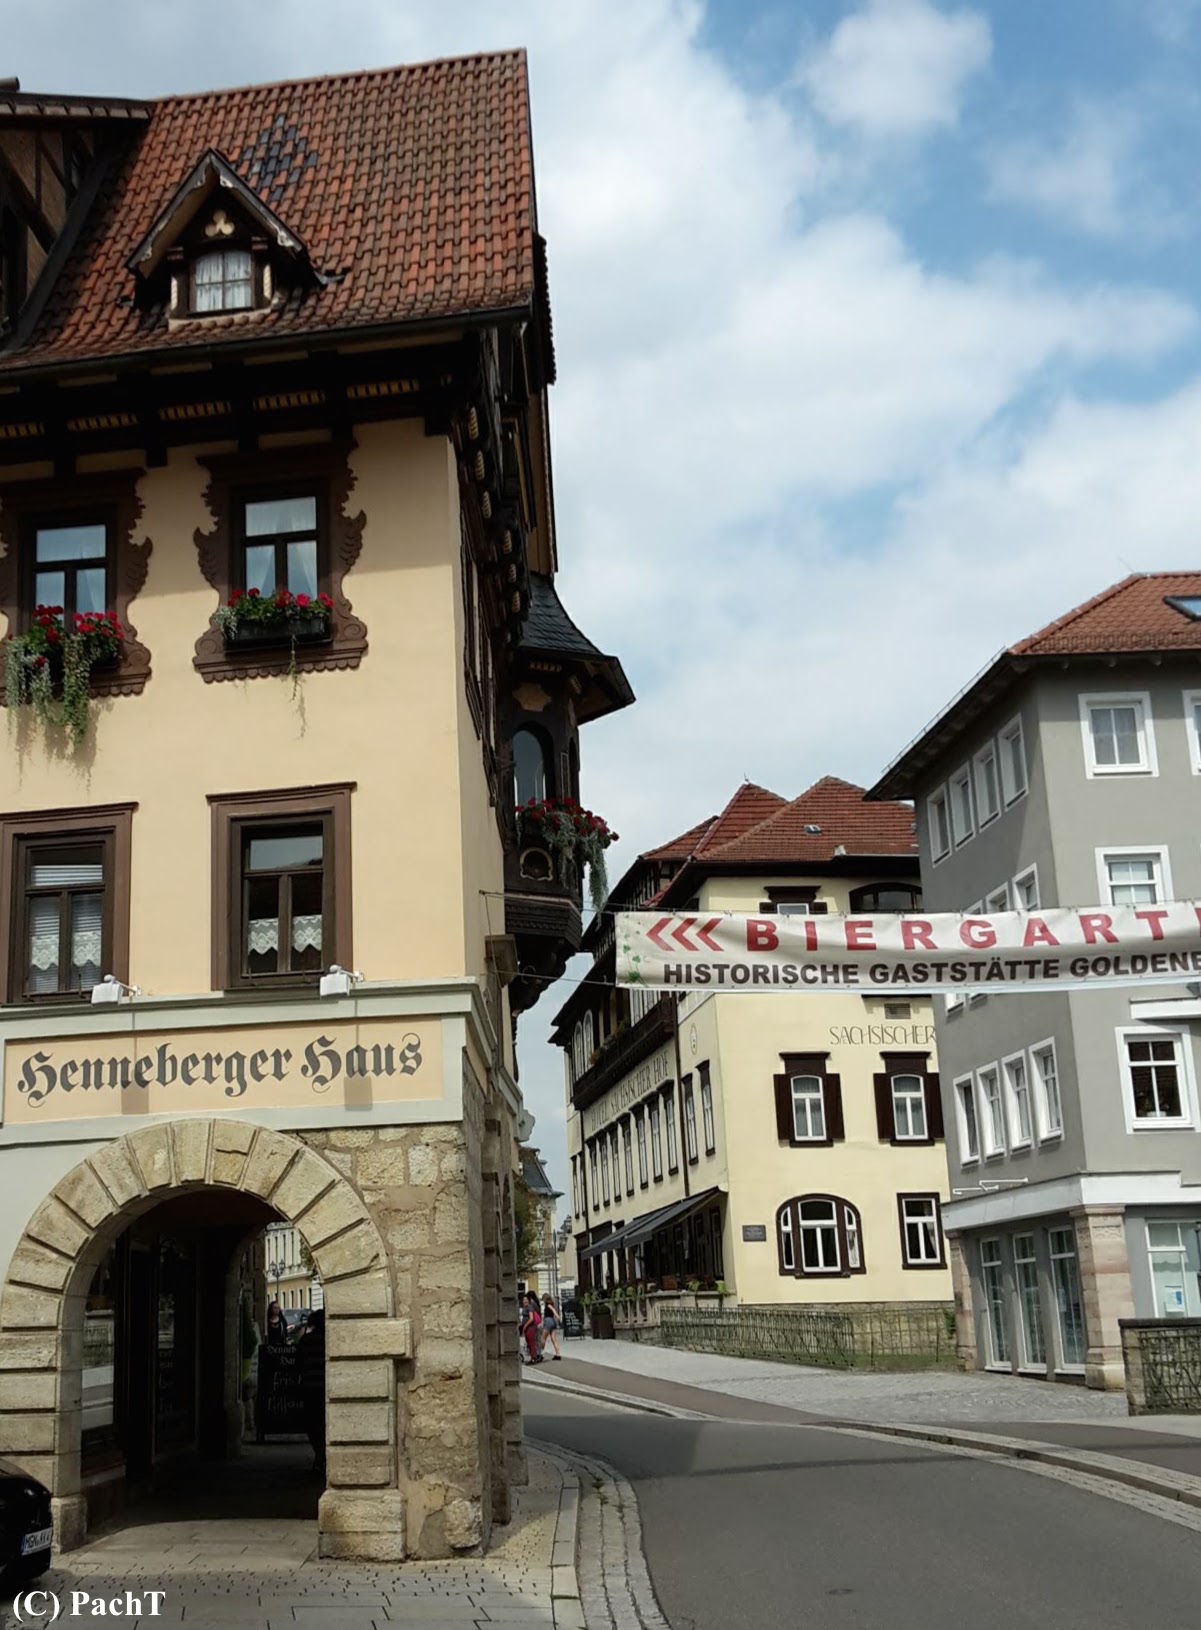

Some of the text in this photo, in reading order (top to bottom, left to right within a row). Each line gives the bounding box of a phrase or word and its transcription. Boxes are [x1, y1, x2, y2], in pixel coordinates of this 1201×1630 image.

[746, 907, 1201, 952] BIERGART
[663, 963, 859, 985] HISTORISCHE
[868, 957, 1059, 983] GASTSTÄTTE
[17, 1032, 423, 1109] Henneberger Haus
